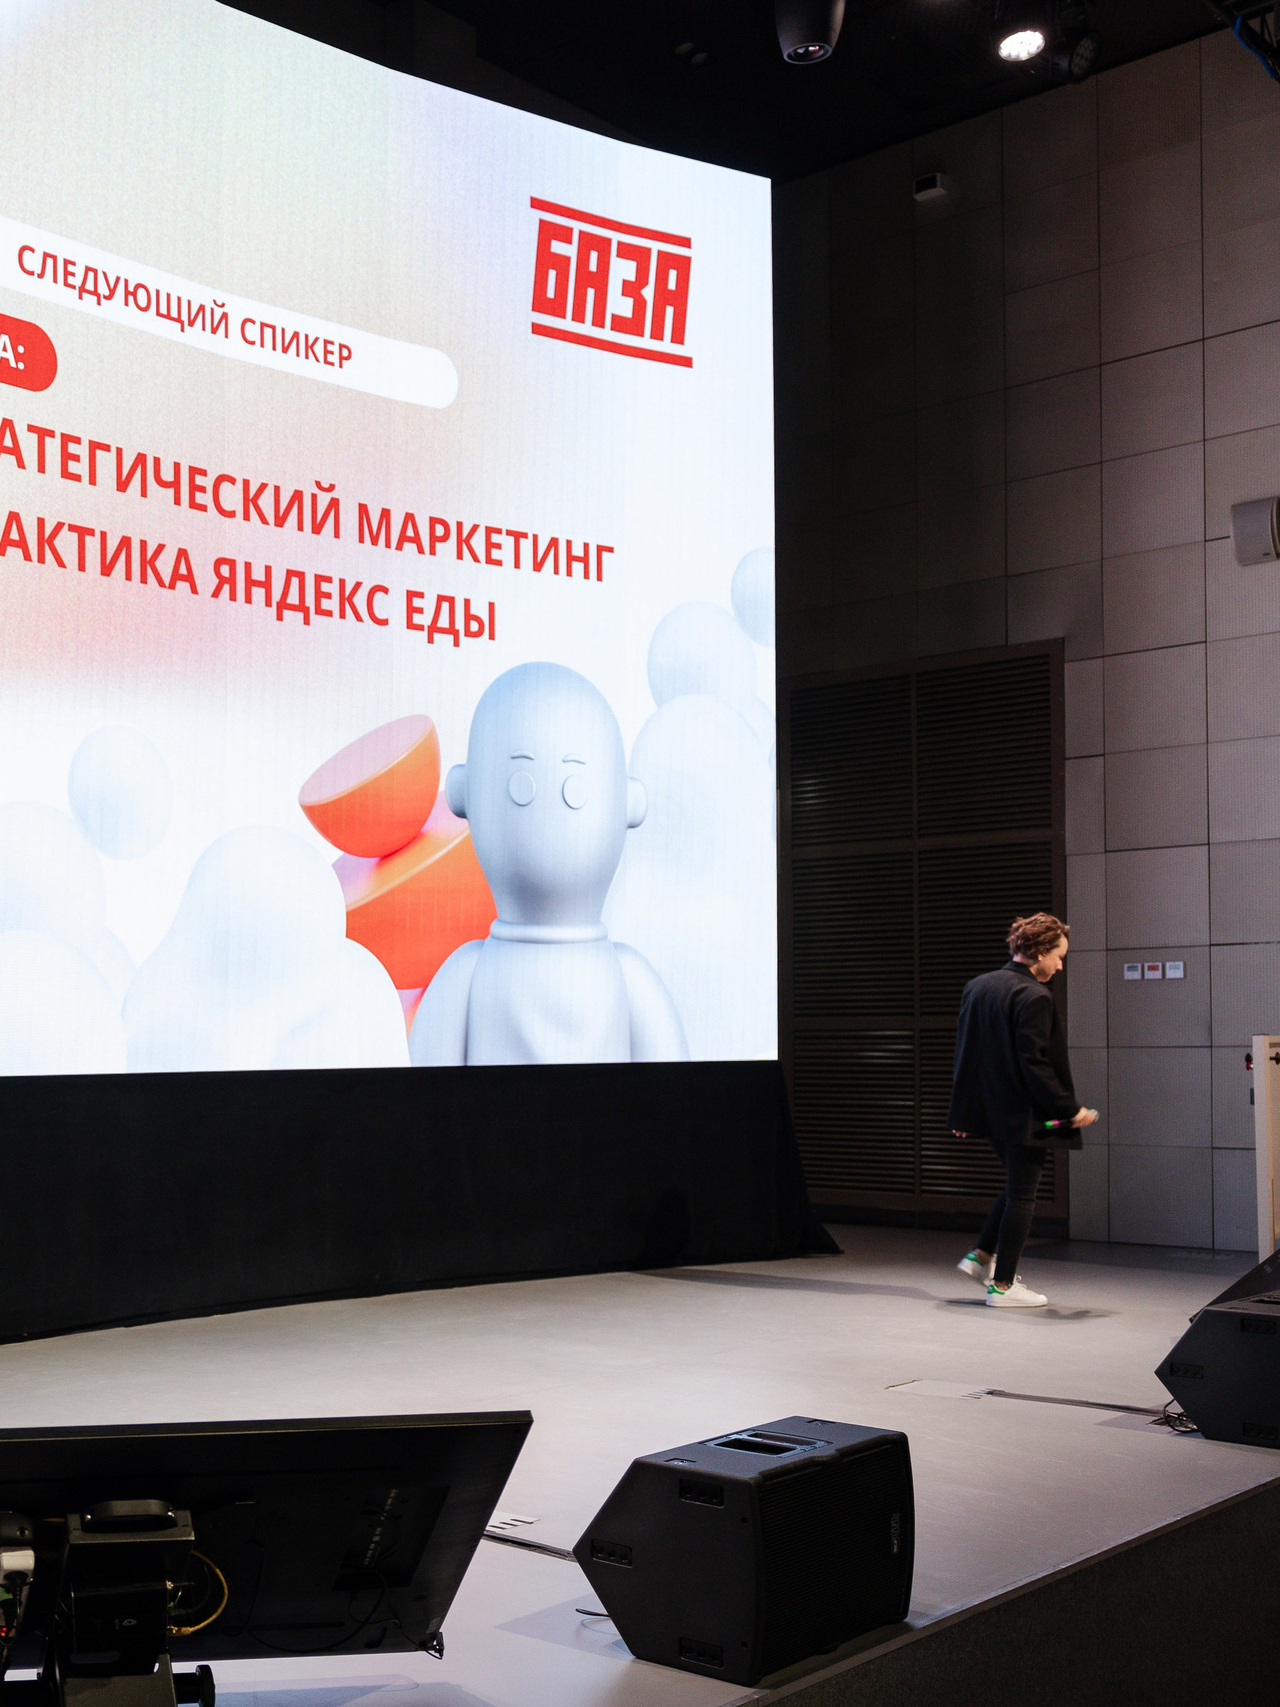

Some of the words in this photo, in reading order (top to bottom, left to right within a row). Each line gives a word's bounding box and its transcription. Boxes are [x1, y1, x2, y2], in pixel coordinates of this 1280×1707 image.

[17, 244, 230, 340] СЛЕДУЮЩИЙ
[240, 316, 353, 370] СПИКЕР
[531, 218, 692, 345] БАЗА
[357, 501, 616, 583] МАРКЕТИНГ
[210, 555, 391, 627] ЯНДЕКС
[405, 589, 497, 648] ЕДЫ
